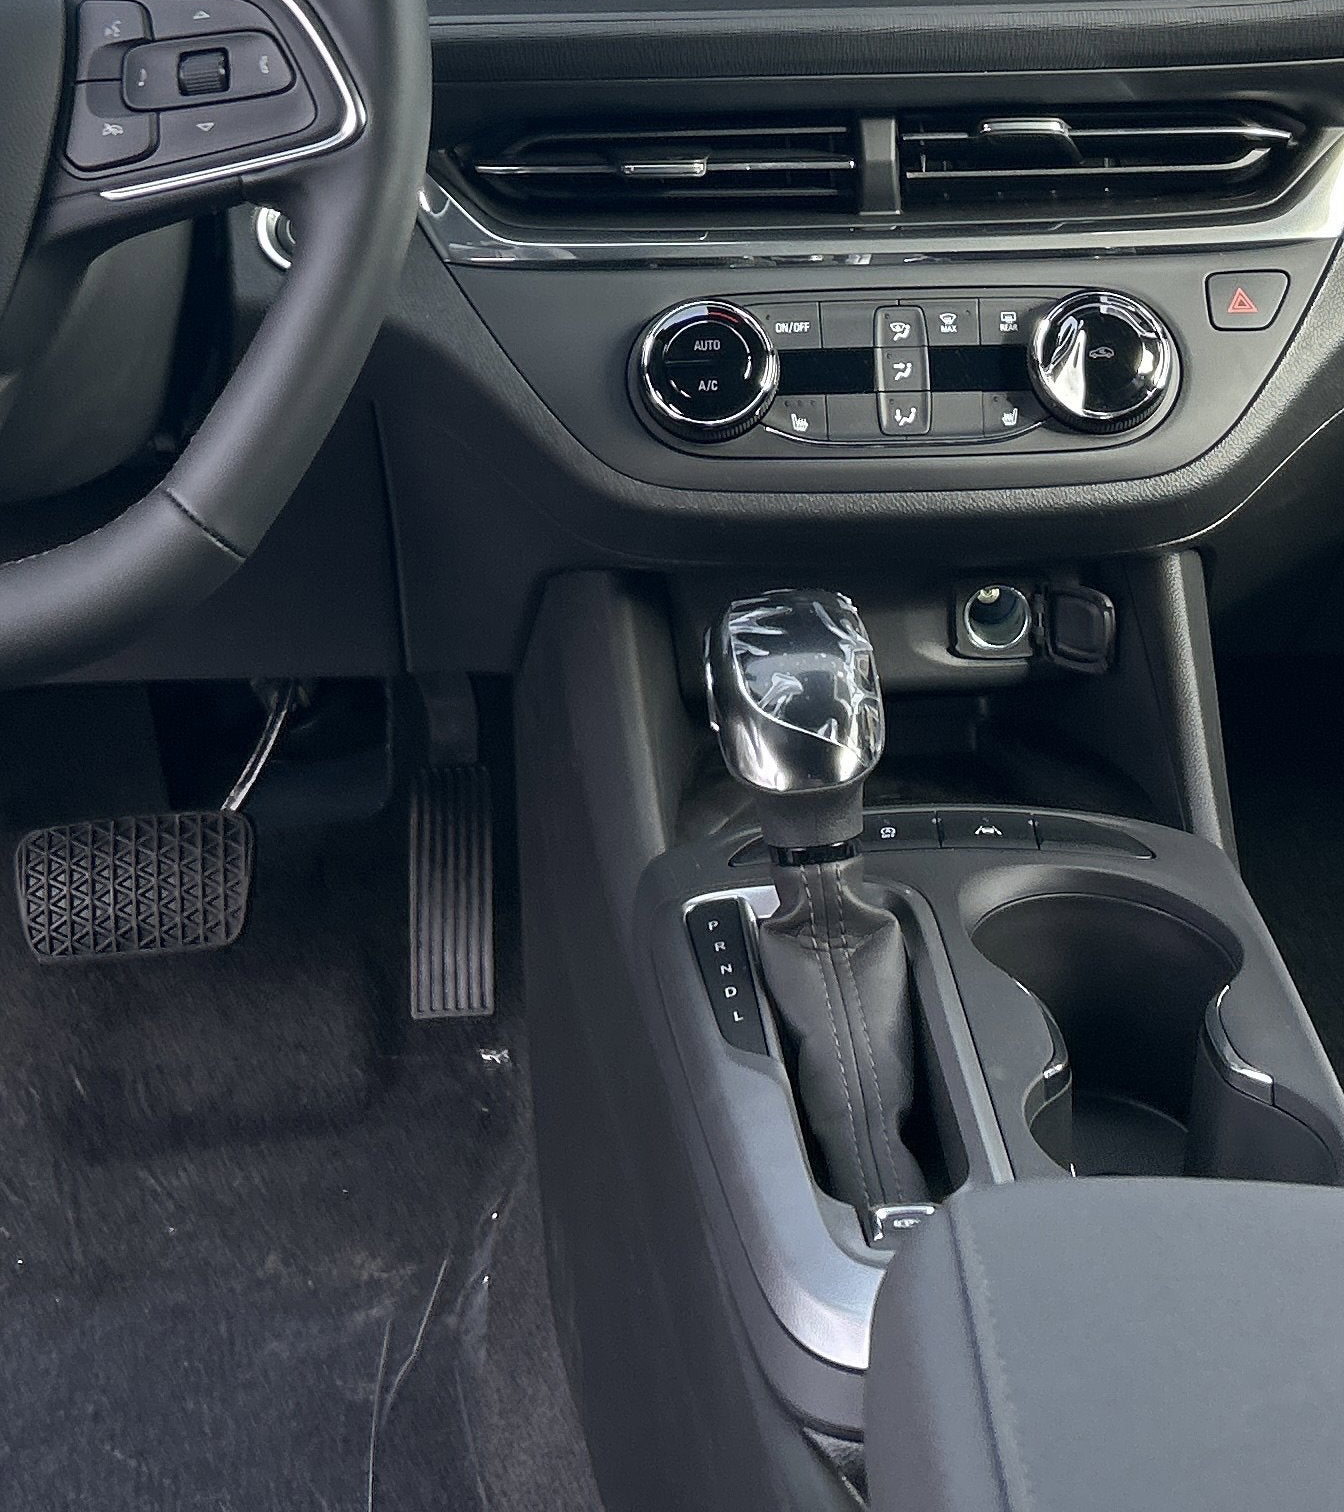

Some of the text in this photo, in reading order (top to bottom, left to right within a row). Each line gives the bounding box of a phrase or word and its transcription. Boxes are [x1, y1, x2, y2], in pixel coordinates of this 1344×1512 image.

[775, 322, 810, 333] ON/OFF
[940, 325, 958, 333] MAX
[999, 323, 1018, 332] REAR
[694, 340, 721, 351] AUTO
[698, 380, 718, 391] A/C
[708, 920, 719, 931] P
[714, 941, 726, 952] R
[720, 963, 733, 975] N
[724, 986, 737, 998] D
[733, 1011, 744, 1022] L
